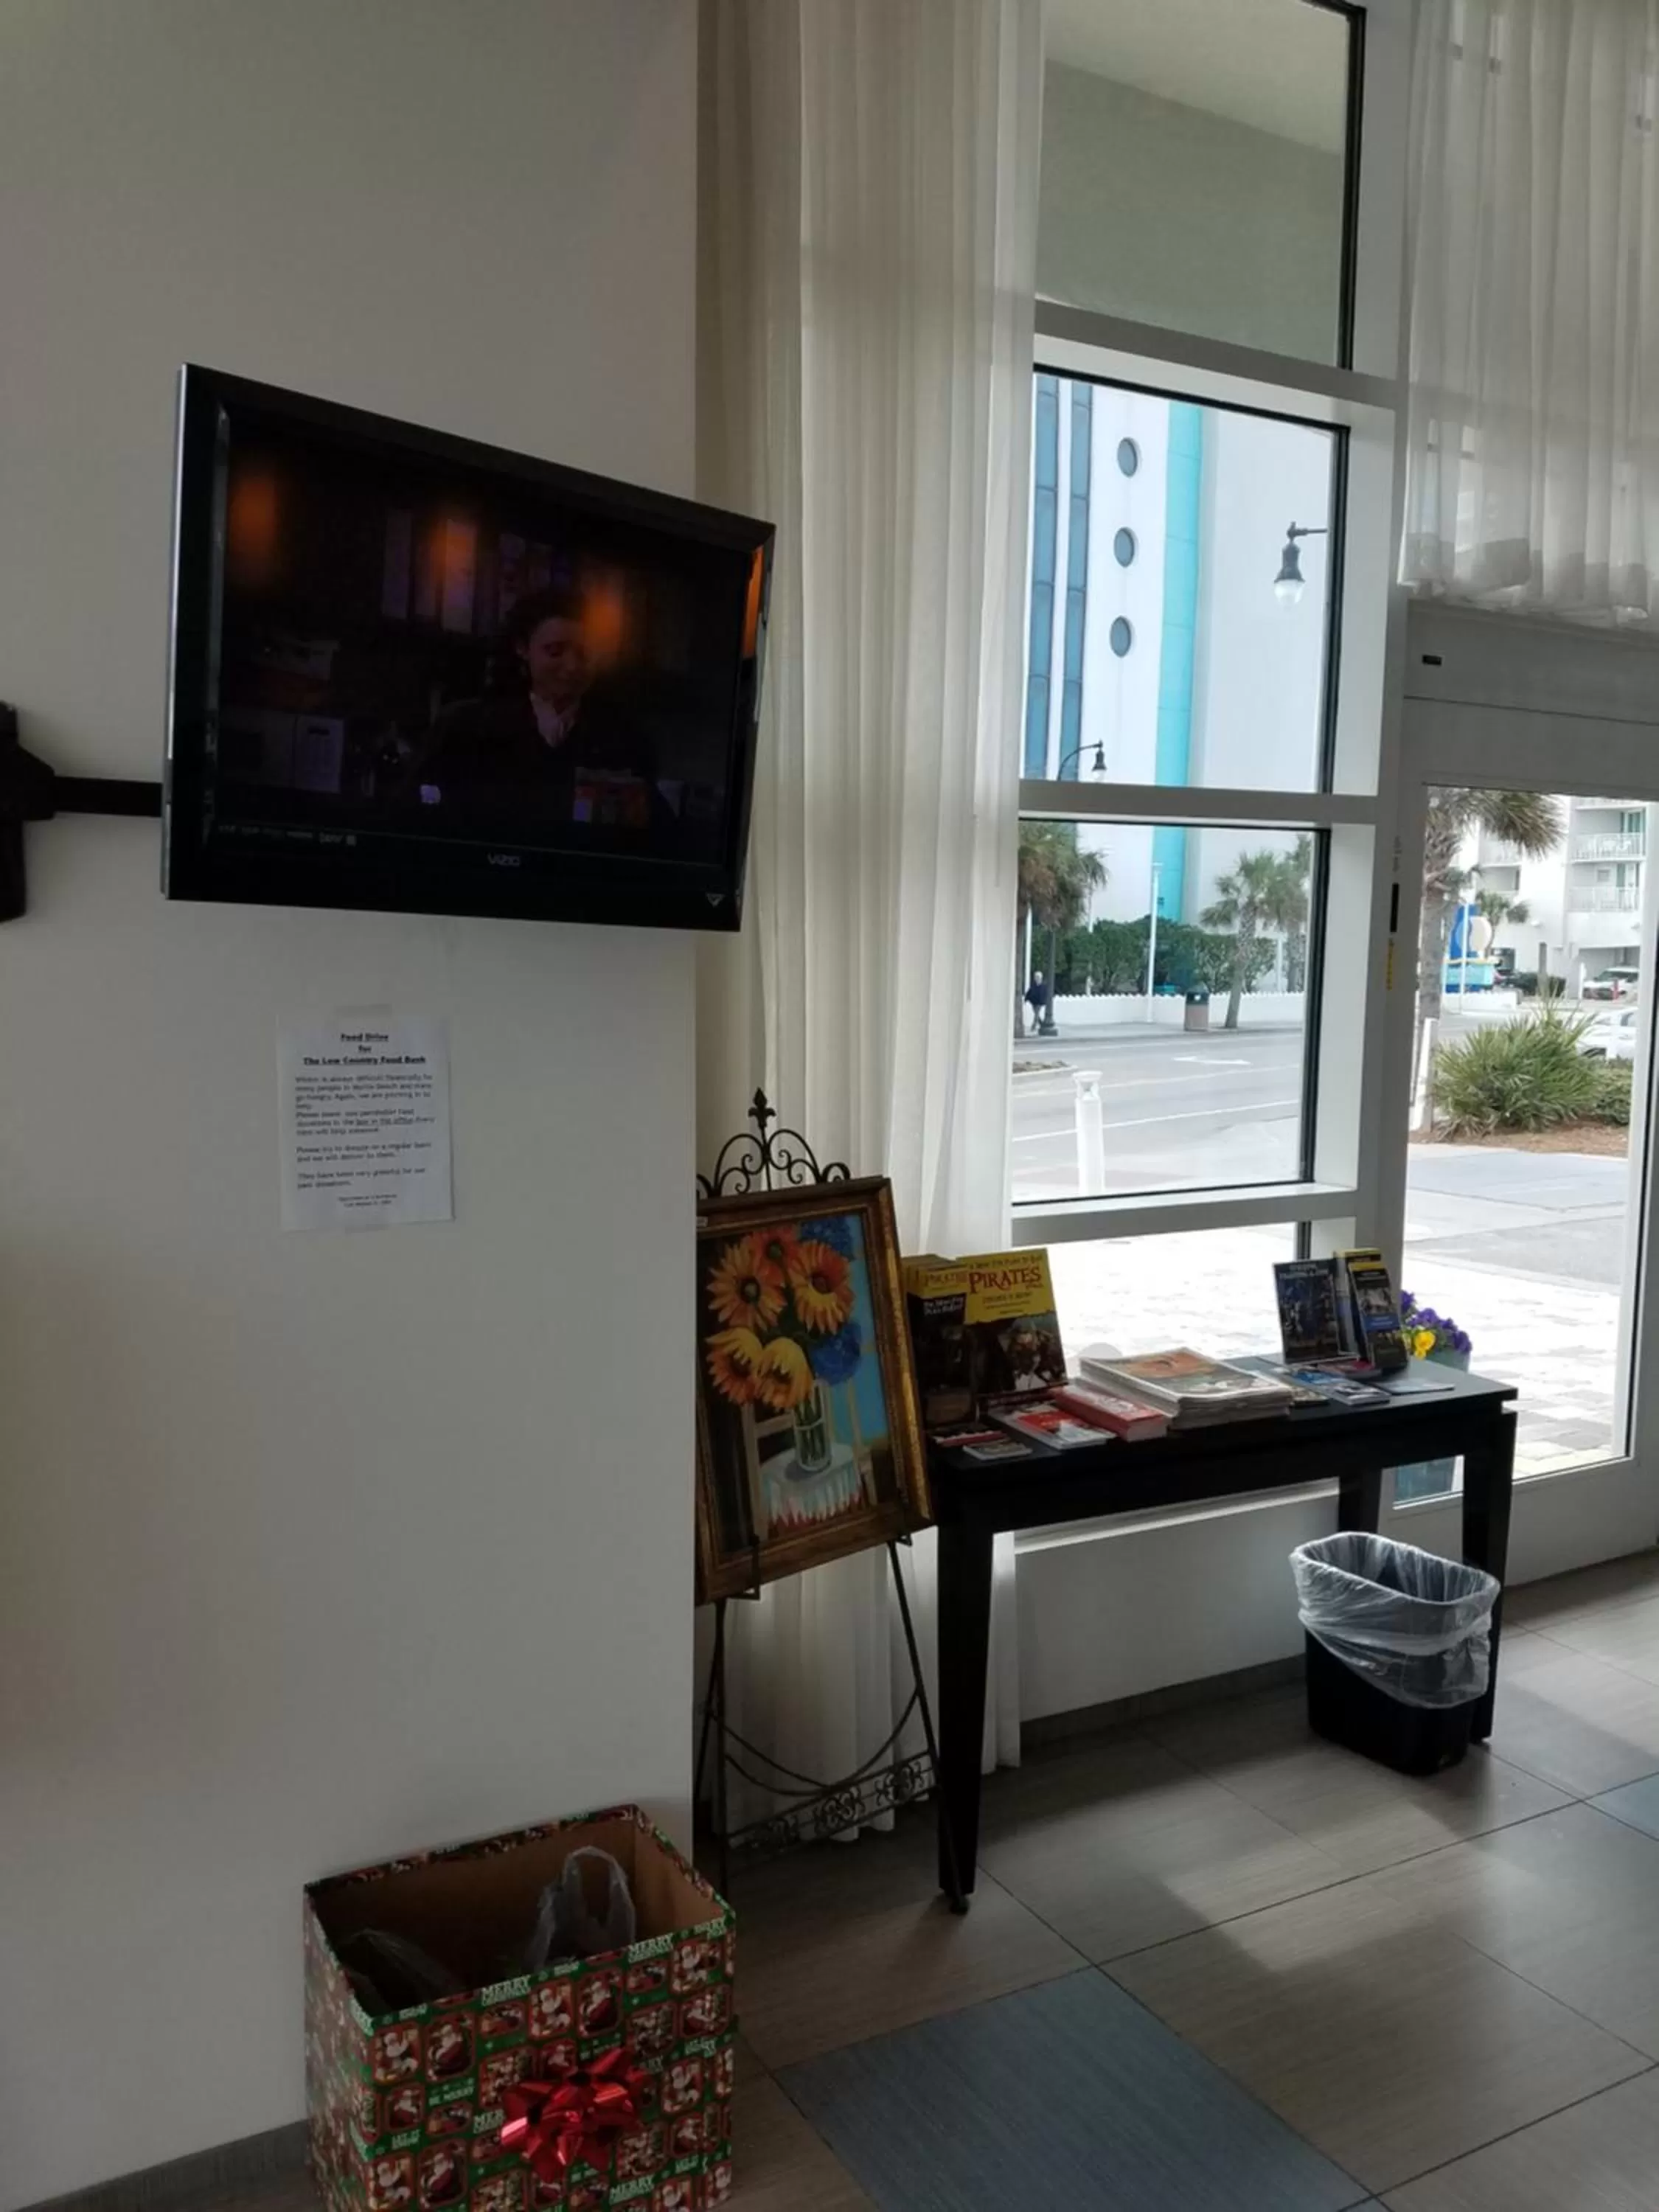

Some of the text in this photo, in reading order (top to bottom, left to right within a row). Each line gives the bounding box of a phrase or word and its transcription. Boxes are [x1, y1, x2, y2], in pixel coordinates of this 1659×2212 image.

[341, 1034, 363, 1042] Food
[343, 1057, 378, 1065] Country
[380, 1057, 403, 1065] Food
[969, 1267, 1041, 1293] PIRATES
